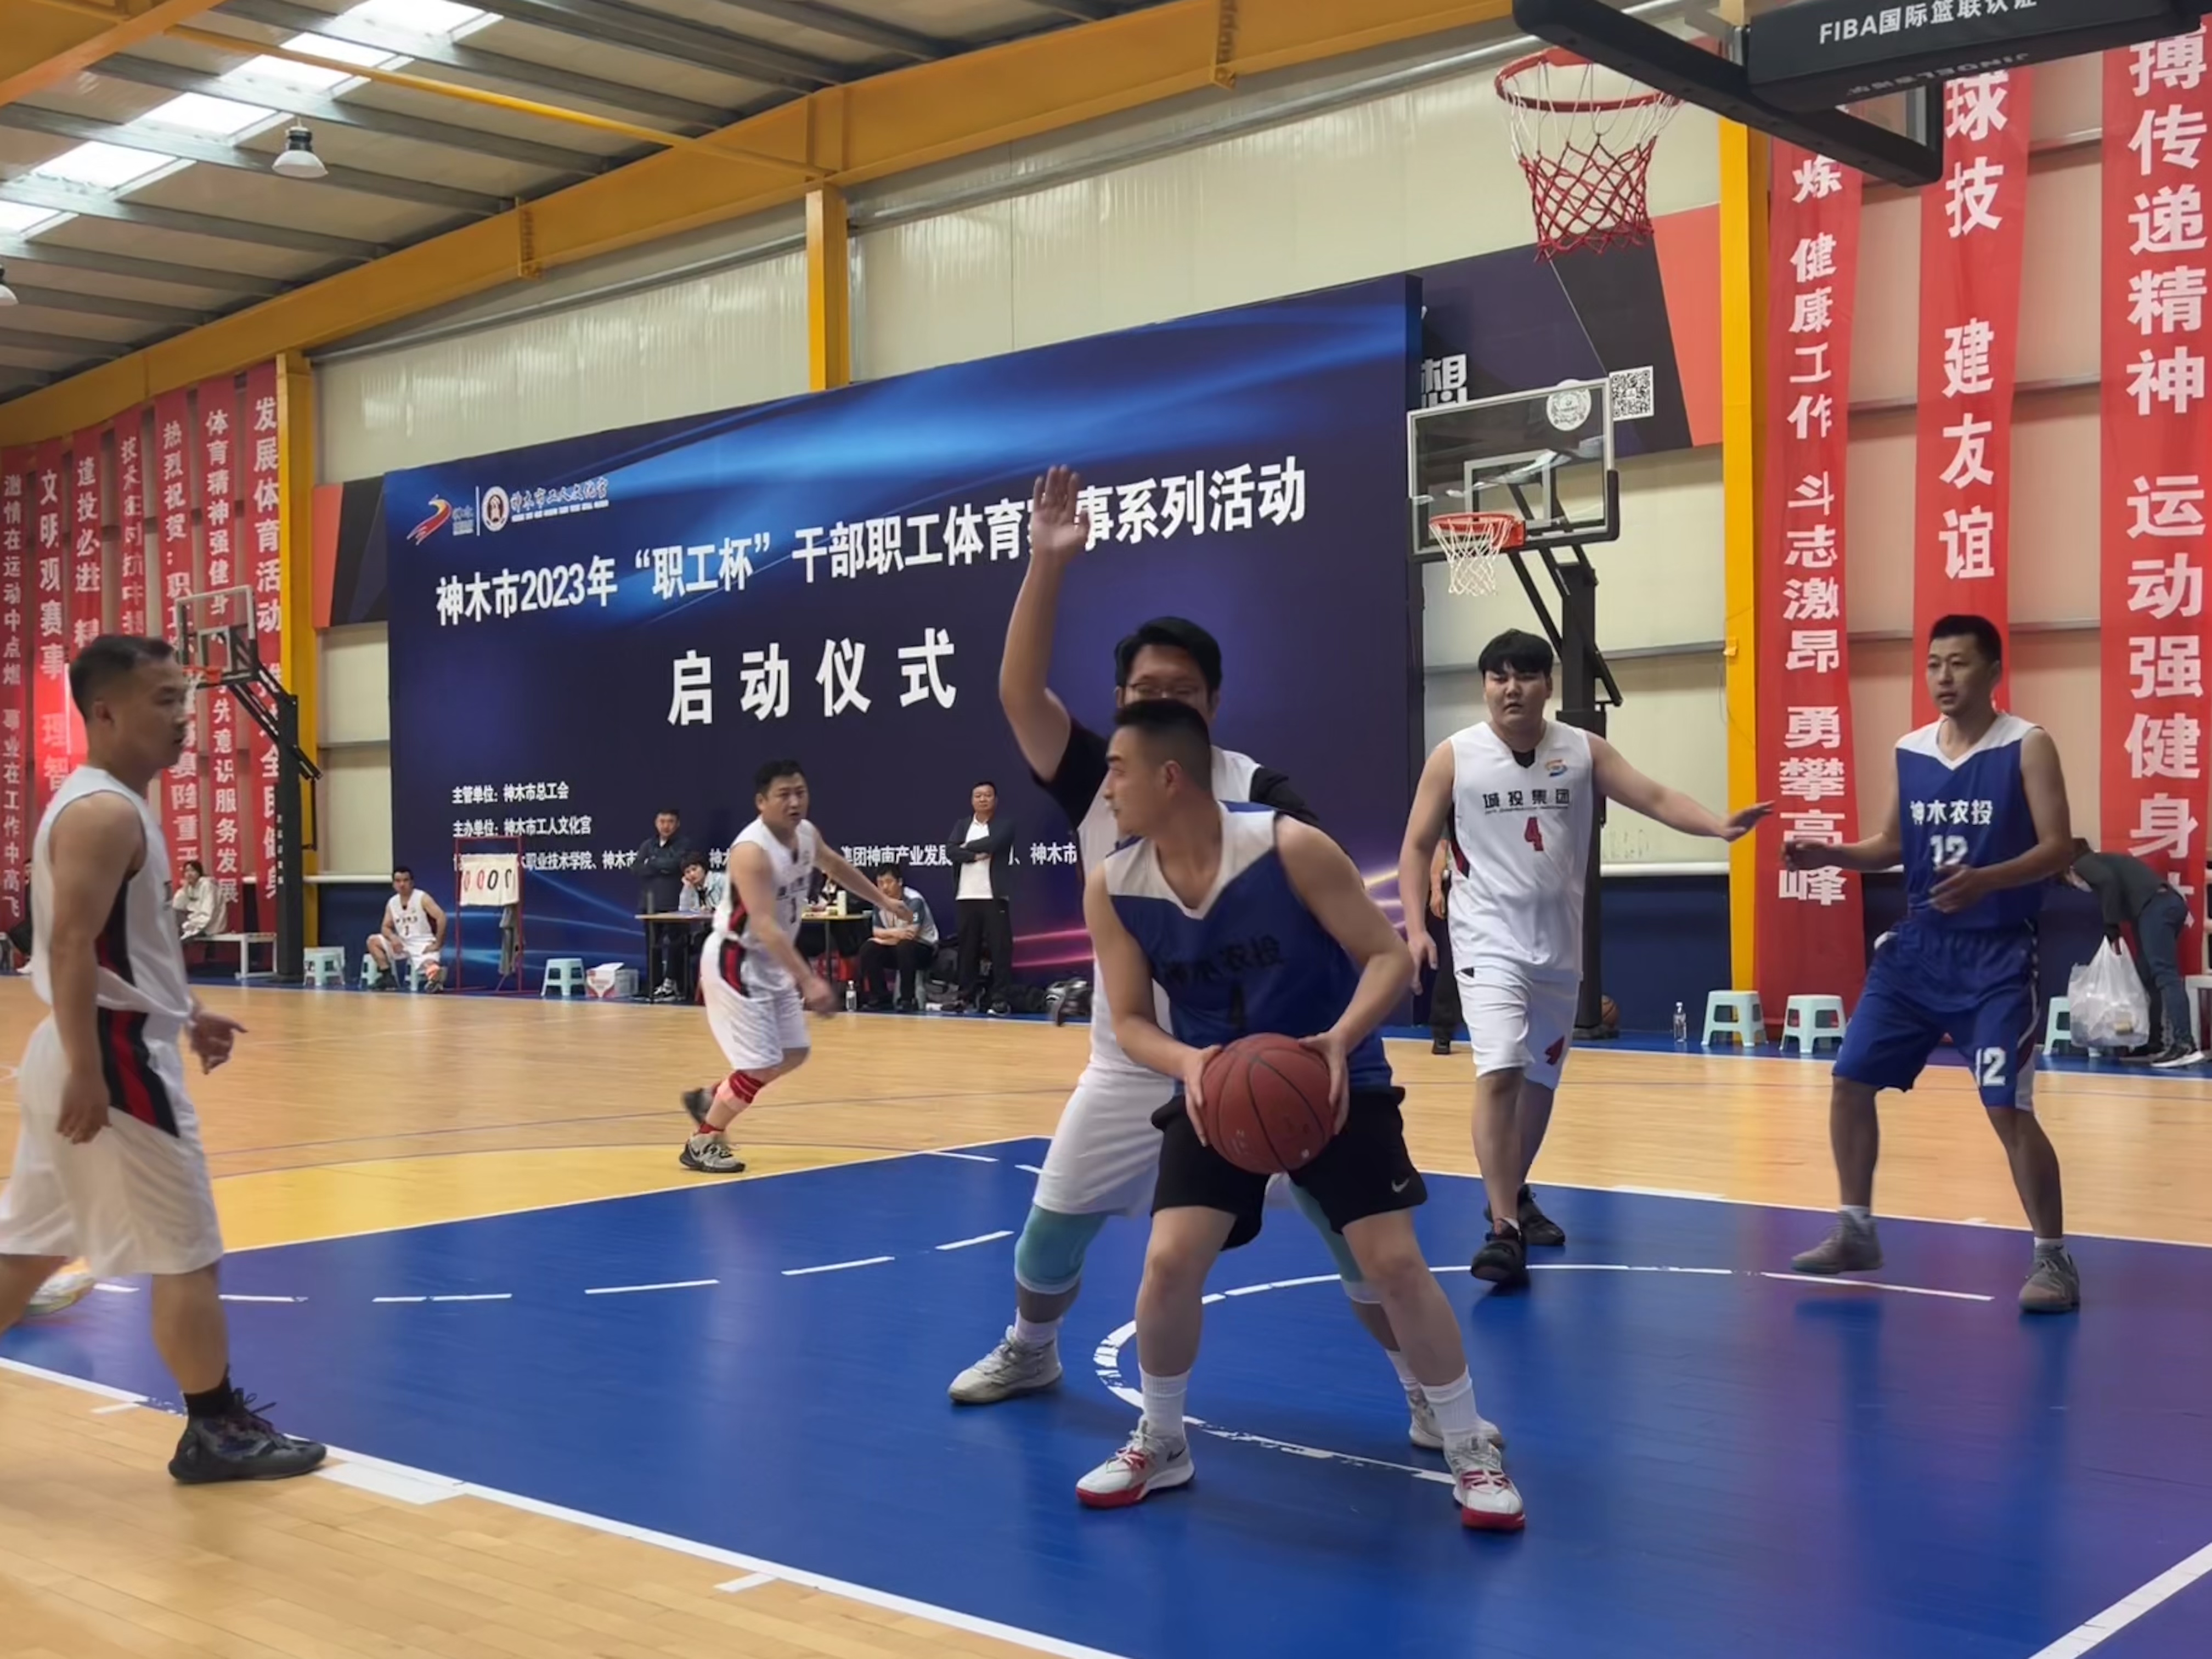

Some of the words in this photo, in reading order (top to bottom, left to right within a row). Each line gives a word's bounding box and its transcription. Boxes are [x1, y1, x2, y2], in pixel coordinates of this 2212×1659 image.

[1944, 70, 2009, 238] 球技
[1787, 232, 1837, 438] 健康工作
[206, 409, 230, 642] 体育精神强健身
[1939, 318, 1995, 580] 建友谊
[436, 456, 1306, 626] 神木市2023年“职工杯”干部职工体育事系列活动
[1782, 471, 1839, 674] 斗志激昂
[668, 627, 957, 725] 启动仪式
[2125, 474, 2206, 927] 运动强健身
[521, 851, 638, 871] 职业技术学院、神木市
[1523, 817, 1543, 851] 4
[1779, 706, 1847, 906] 勇攀高峰
[1910, 799, 1993, 825] 神木农投
[1975, 1047, 2006, 1086] 12
